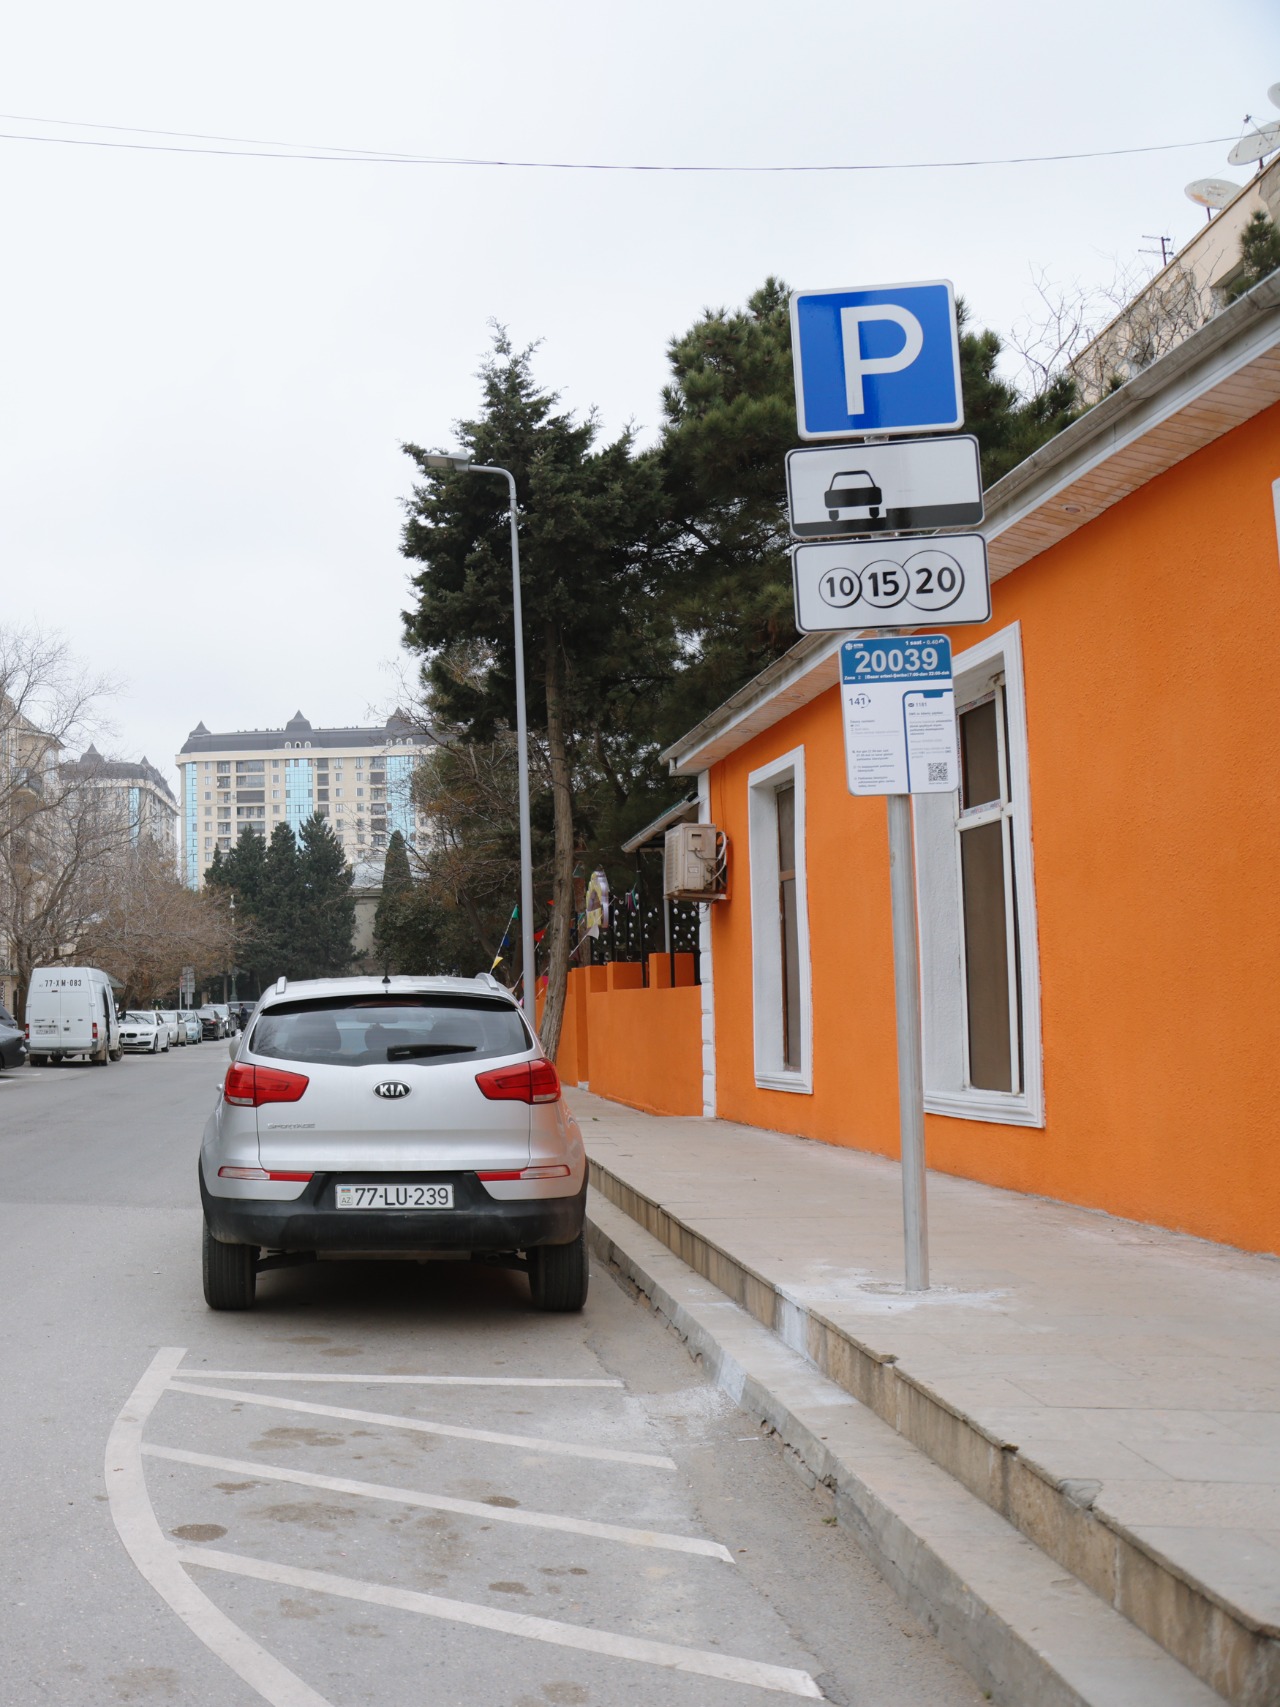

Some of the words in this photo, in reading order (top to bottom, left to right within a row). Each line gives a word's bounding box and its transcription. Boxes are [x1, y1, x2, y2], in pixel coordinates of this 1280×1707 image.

[840, 303, 924, 416] P
[825, 575, 855, 598] 10
[867, 570, 900, 598] 15
[915, 566, 956, 595] 20
[854, 647, 938, 673] 20039
[848, 697, 866, 706] 141
[379, 1084, 406, 1096] KIA
[267, 1122, 316, 1130] SPORTAGE
[341, 1196, 352, 1204] AZ
[355, 1187, 449, 1206] 77-LU-239
